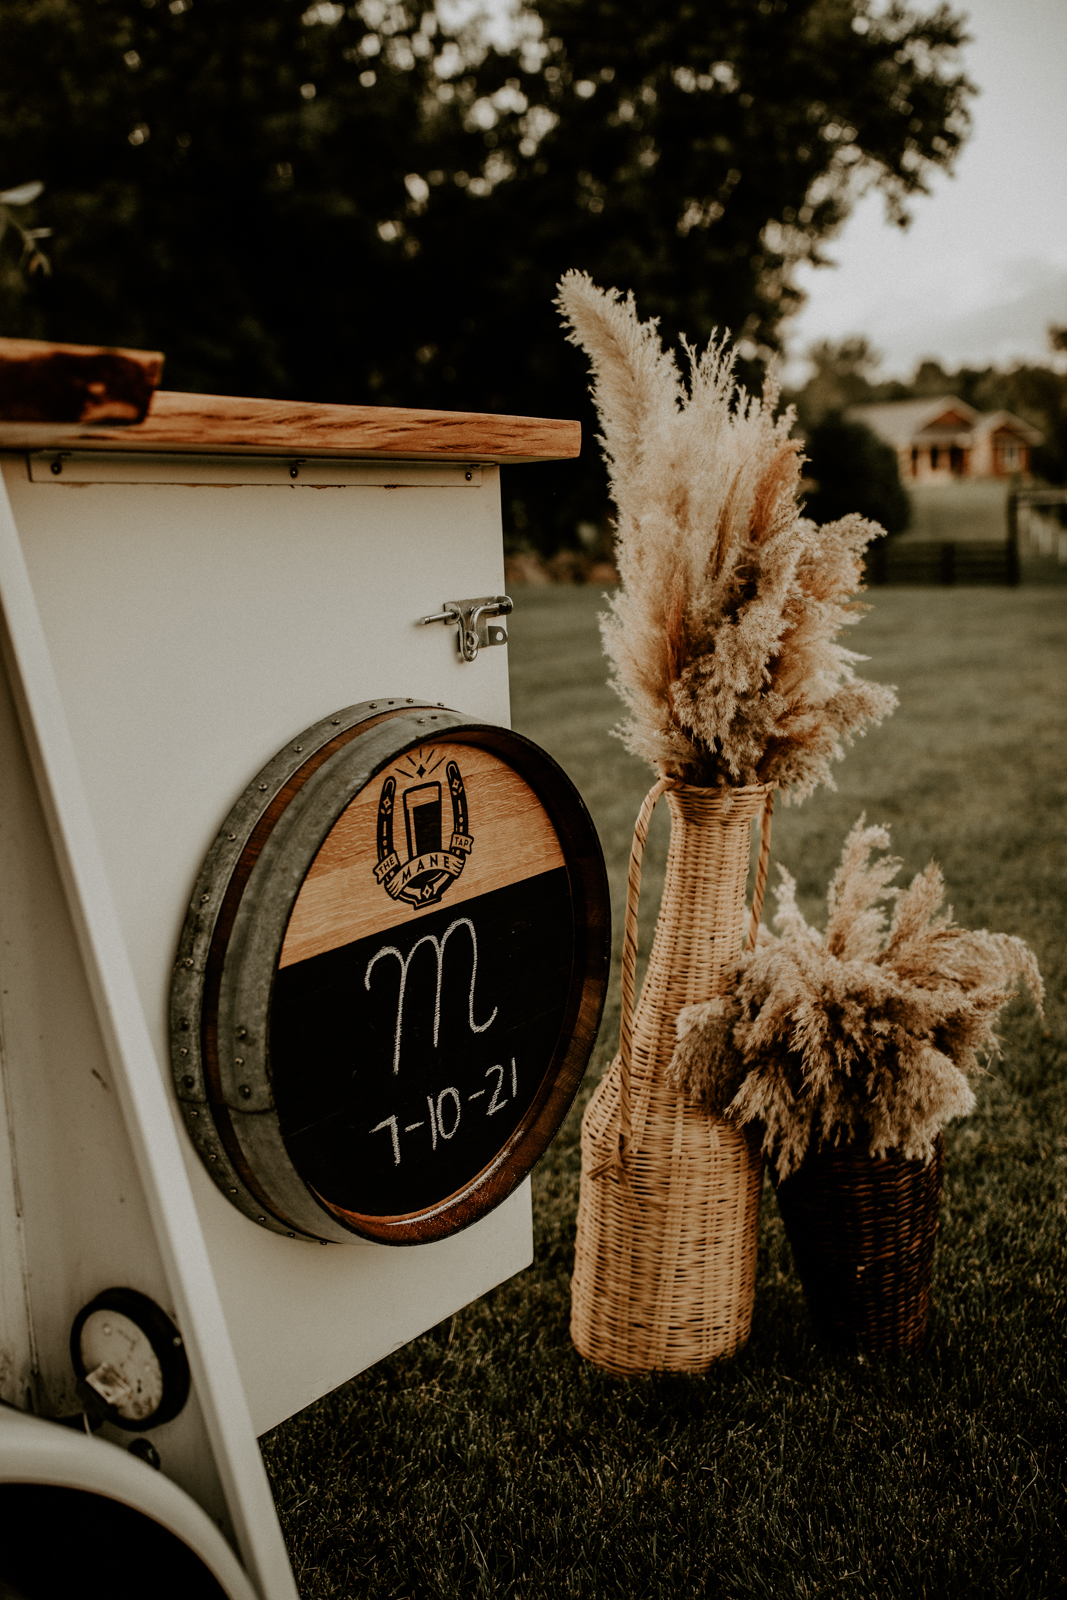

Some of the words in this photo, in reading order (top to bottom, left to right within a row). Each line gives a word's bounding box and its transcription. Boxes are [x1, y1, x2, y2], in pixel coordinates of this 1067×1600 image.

[378, 857, 395, 875] THE
[401, 854, 450, 885] MANE
[454, 836, 469, 847] TAP
[369, 1056, 518, 1167] 7-10-21
